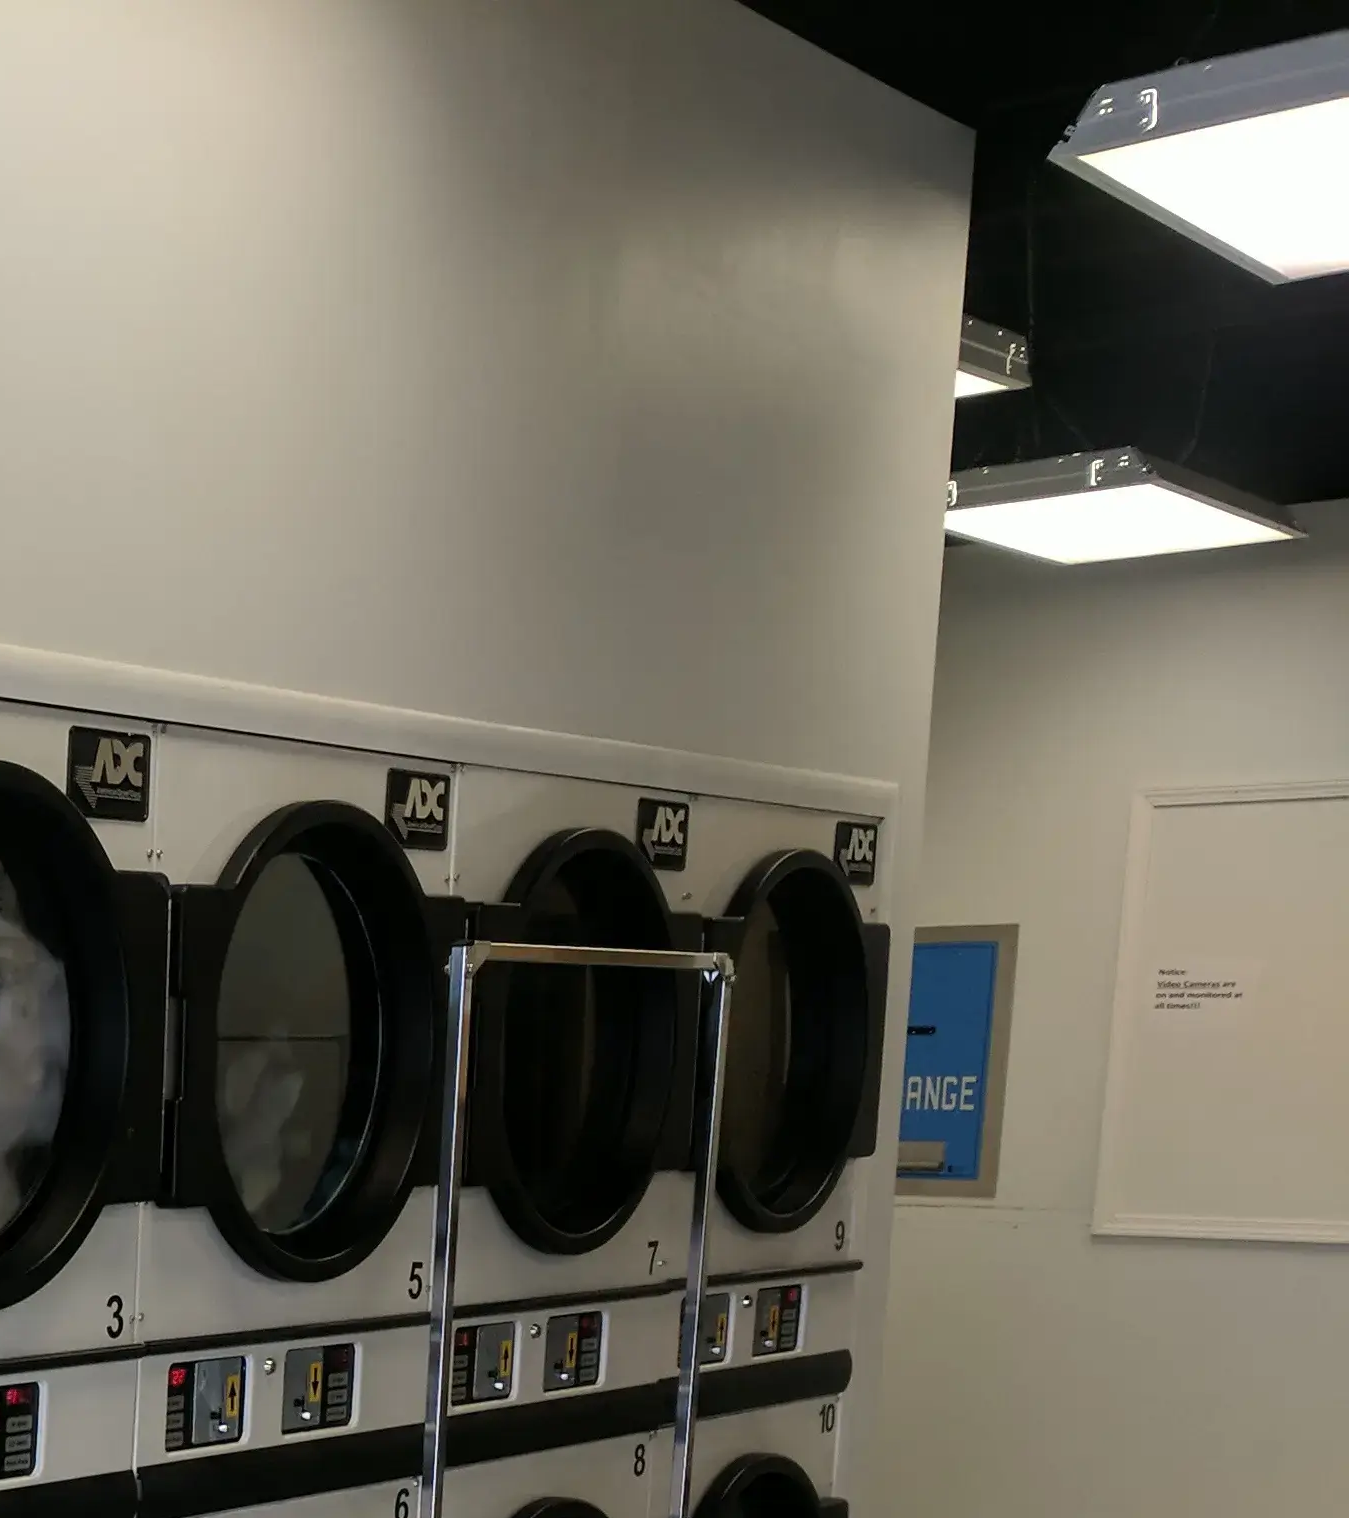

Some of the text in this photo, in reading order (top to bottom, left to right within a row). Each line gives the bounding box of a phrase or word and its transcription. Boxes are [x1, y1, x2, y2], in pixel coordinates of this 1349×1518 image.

[91, 737, 144, 788] ADC
[404, 778, 446, 821] ADC
[651, 805, 686, 845] ADC
[1156, 980, 1181, 988] Video
[1183, 980, 1221, 988] Cameras
[1187, 991, 1232, 999] monitored
[905, 1075, 978, 1111] ANGE
[835, 1220, 845, 1251] 9
[648, 1240, 659, 1276] 7
[408, 1262, 423, 1299] 5
[106, 1295, 124, 1339] 3
[819, 1403, 835, 1434] 10
[633, 1443, 646, 1477] 8
